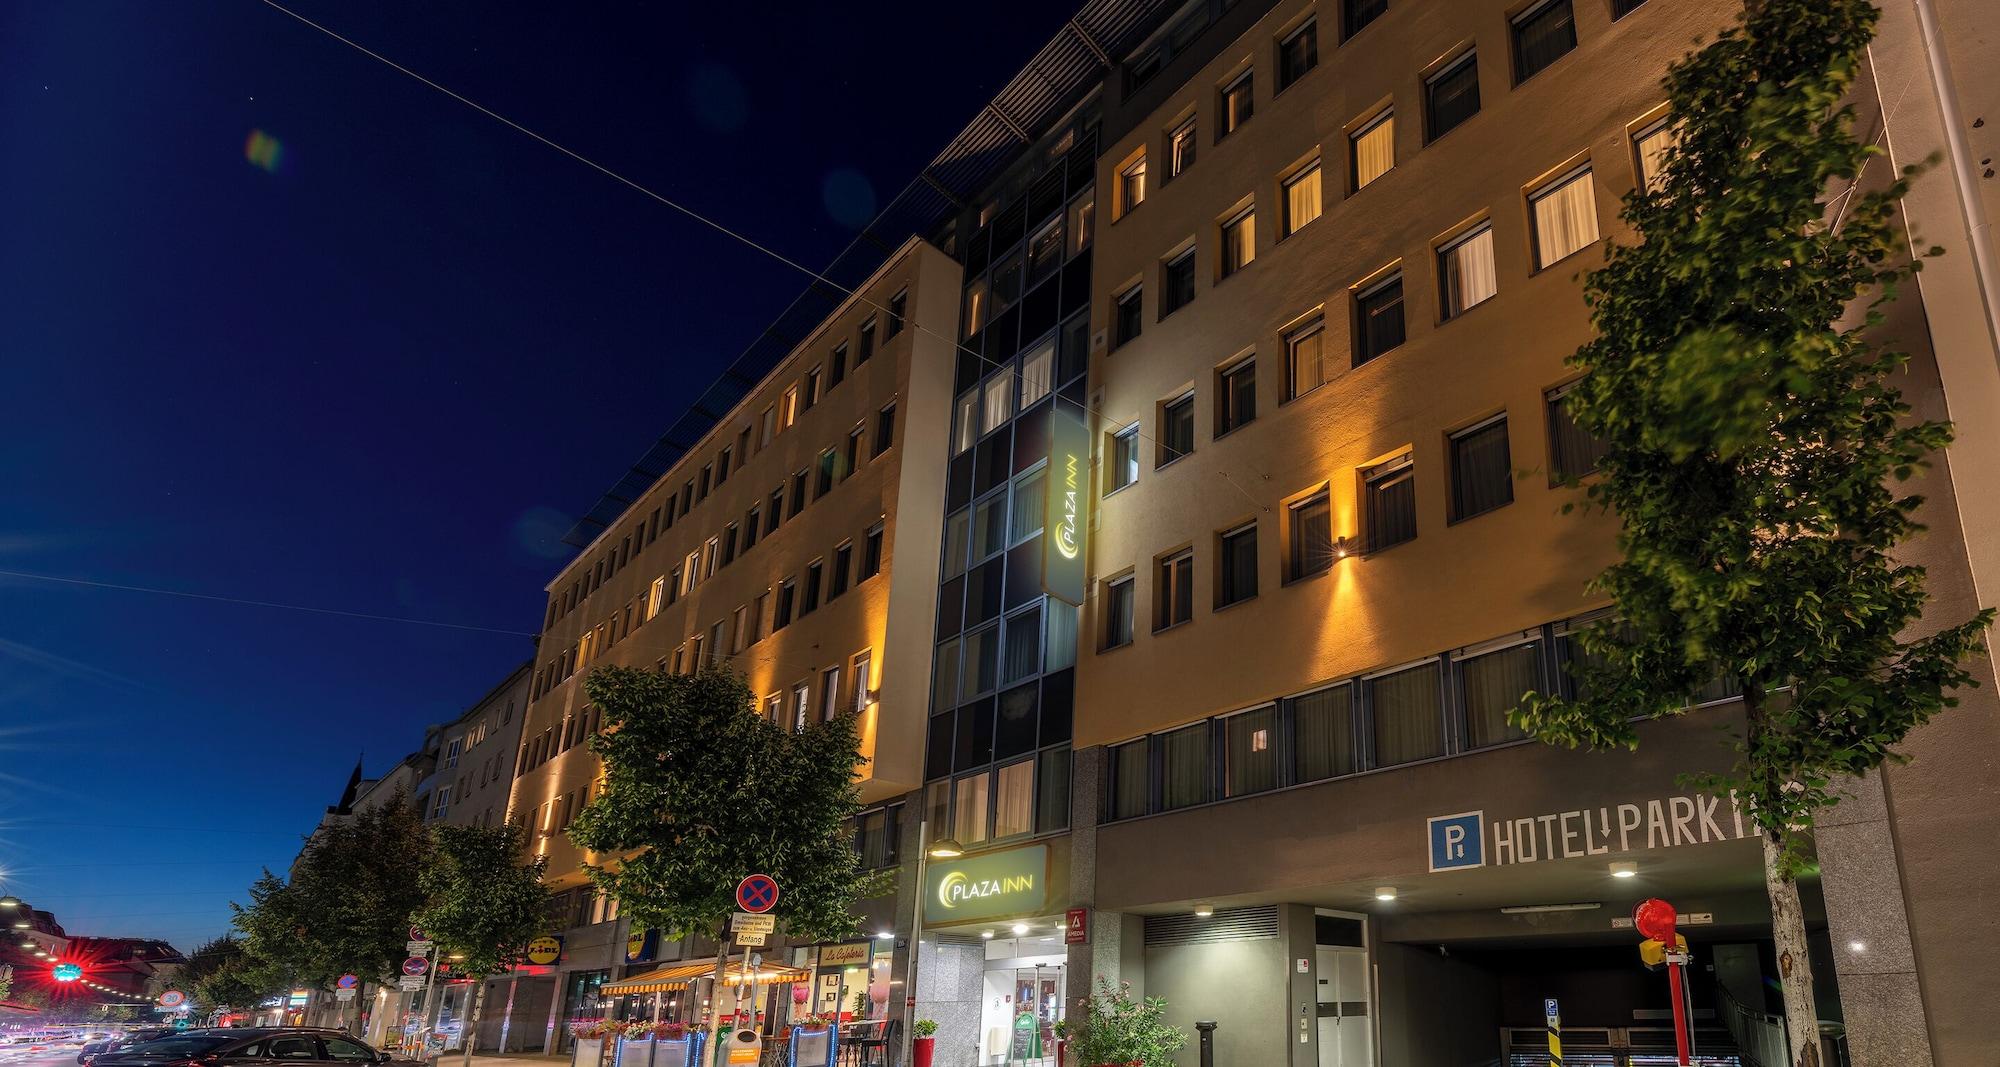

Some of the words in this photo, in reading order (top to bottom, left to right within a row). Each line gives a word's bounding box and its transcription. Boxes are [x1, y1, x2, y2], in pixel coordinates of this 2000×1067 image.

[1066, 454, 1078, 489] INN
[1064, 491, 1076, 544] PLAZA
[1445, 825, 1466, 861] P
[1493, 808, 1609, 866] HOTEL
[953, 880, 1001, 901] PLAZA
[1002, 874, 1033, 894] INN
[739, 934, 763, 944] Anfang
[825, 949, 835, 961] La
